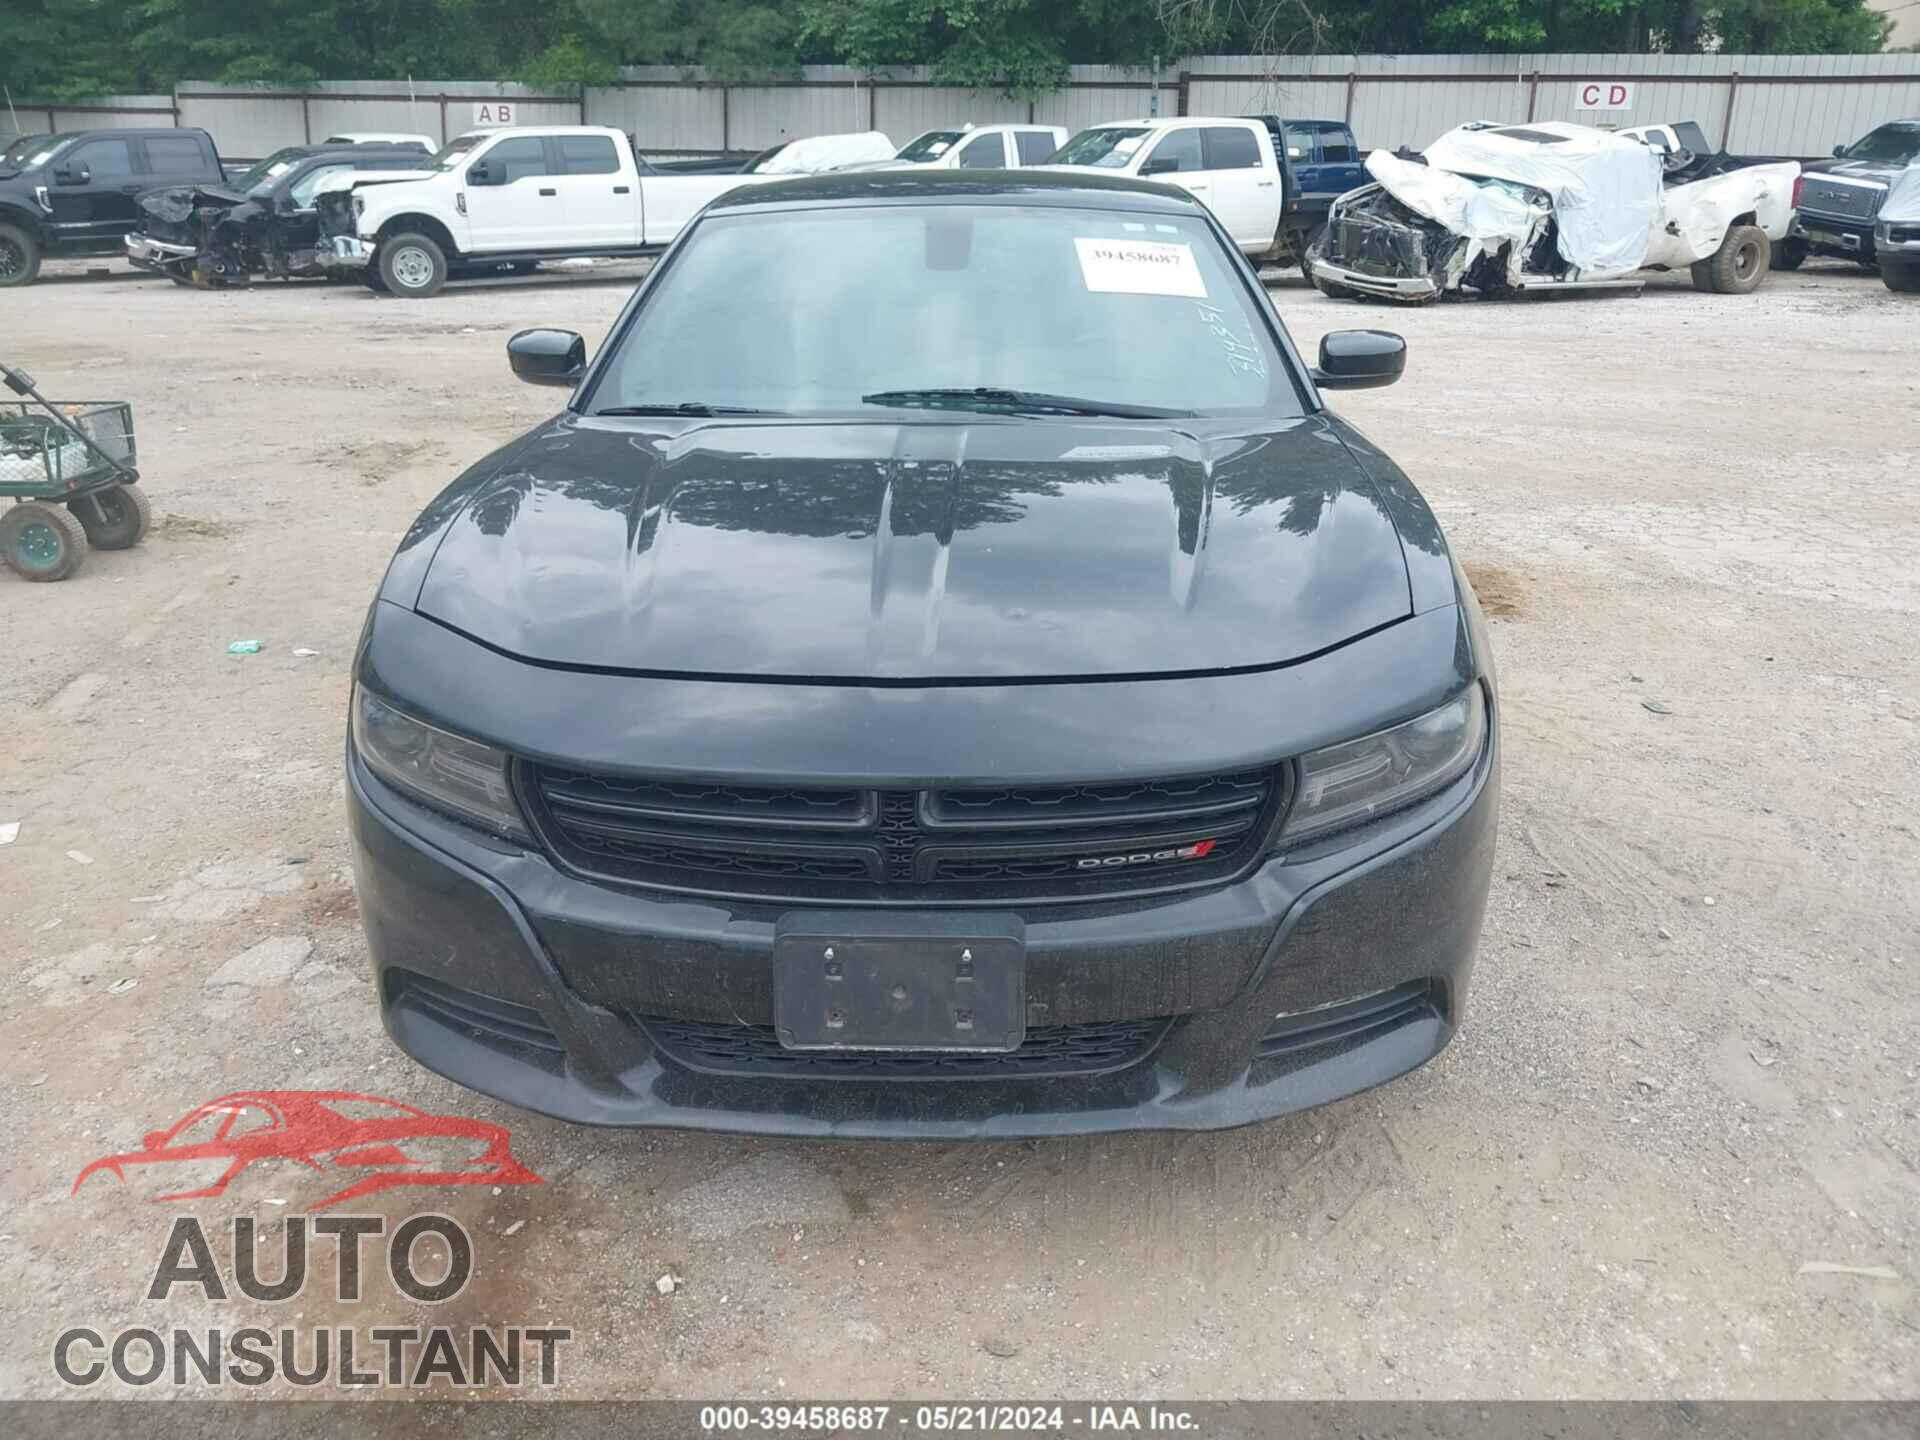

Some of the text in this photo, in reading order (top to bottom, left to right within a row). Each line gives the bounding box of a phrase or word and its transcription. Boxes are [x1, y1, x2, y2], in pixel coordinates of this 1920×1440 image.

[1583, 85, 1626, 105] C D
[480, 105, 511, 121] A B
[1077, 847, 1196, 869] DODGE
